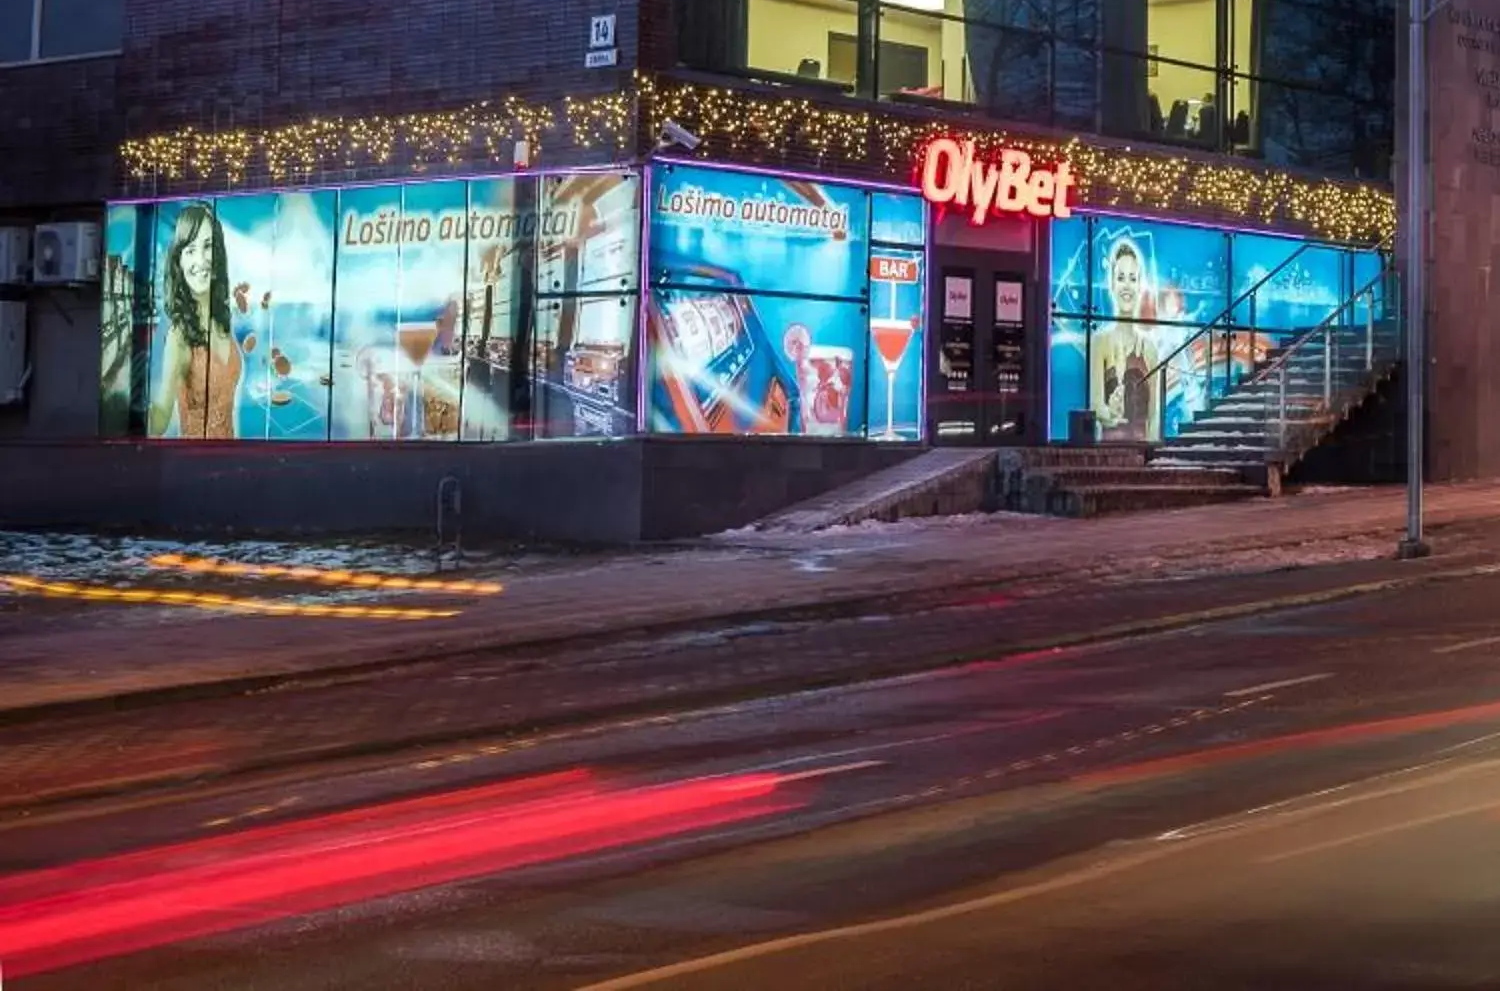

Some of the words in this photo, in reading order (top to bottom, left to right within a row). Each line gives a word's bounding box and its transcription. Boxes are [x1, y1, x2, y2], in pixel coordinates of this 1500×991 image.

[924, 138, 1074, 225] OlyBet
[345, 211, 431, 246] Lošimo
[438, 205, 578, 241] automatai
[656, 184, 736, 219] Lošimo
[741, 199, 848, 230] automatai
[879, 259, 908, 279] BAR
